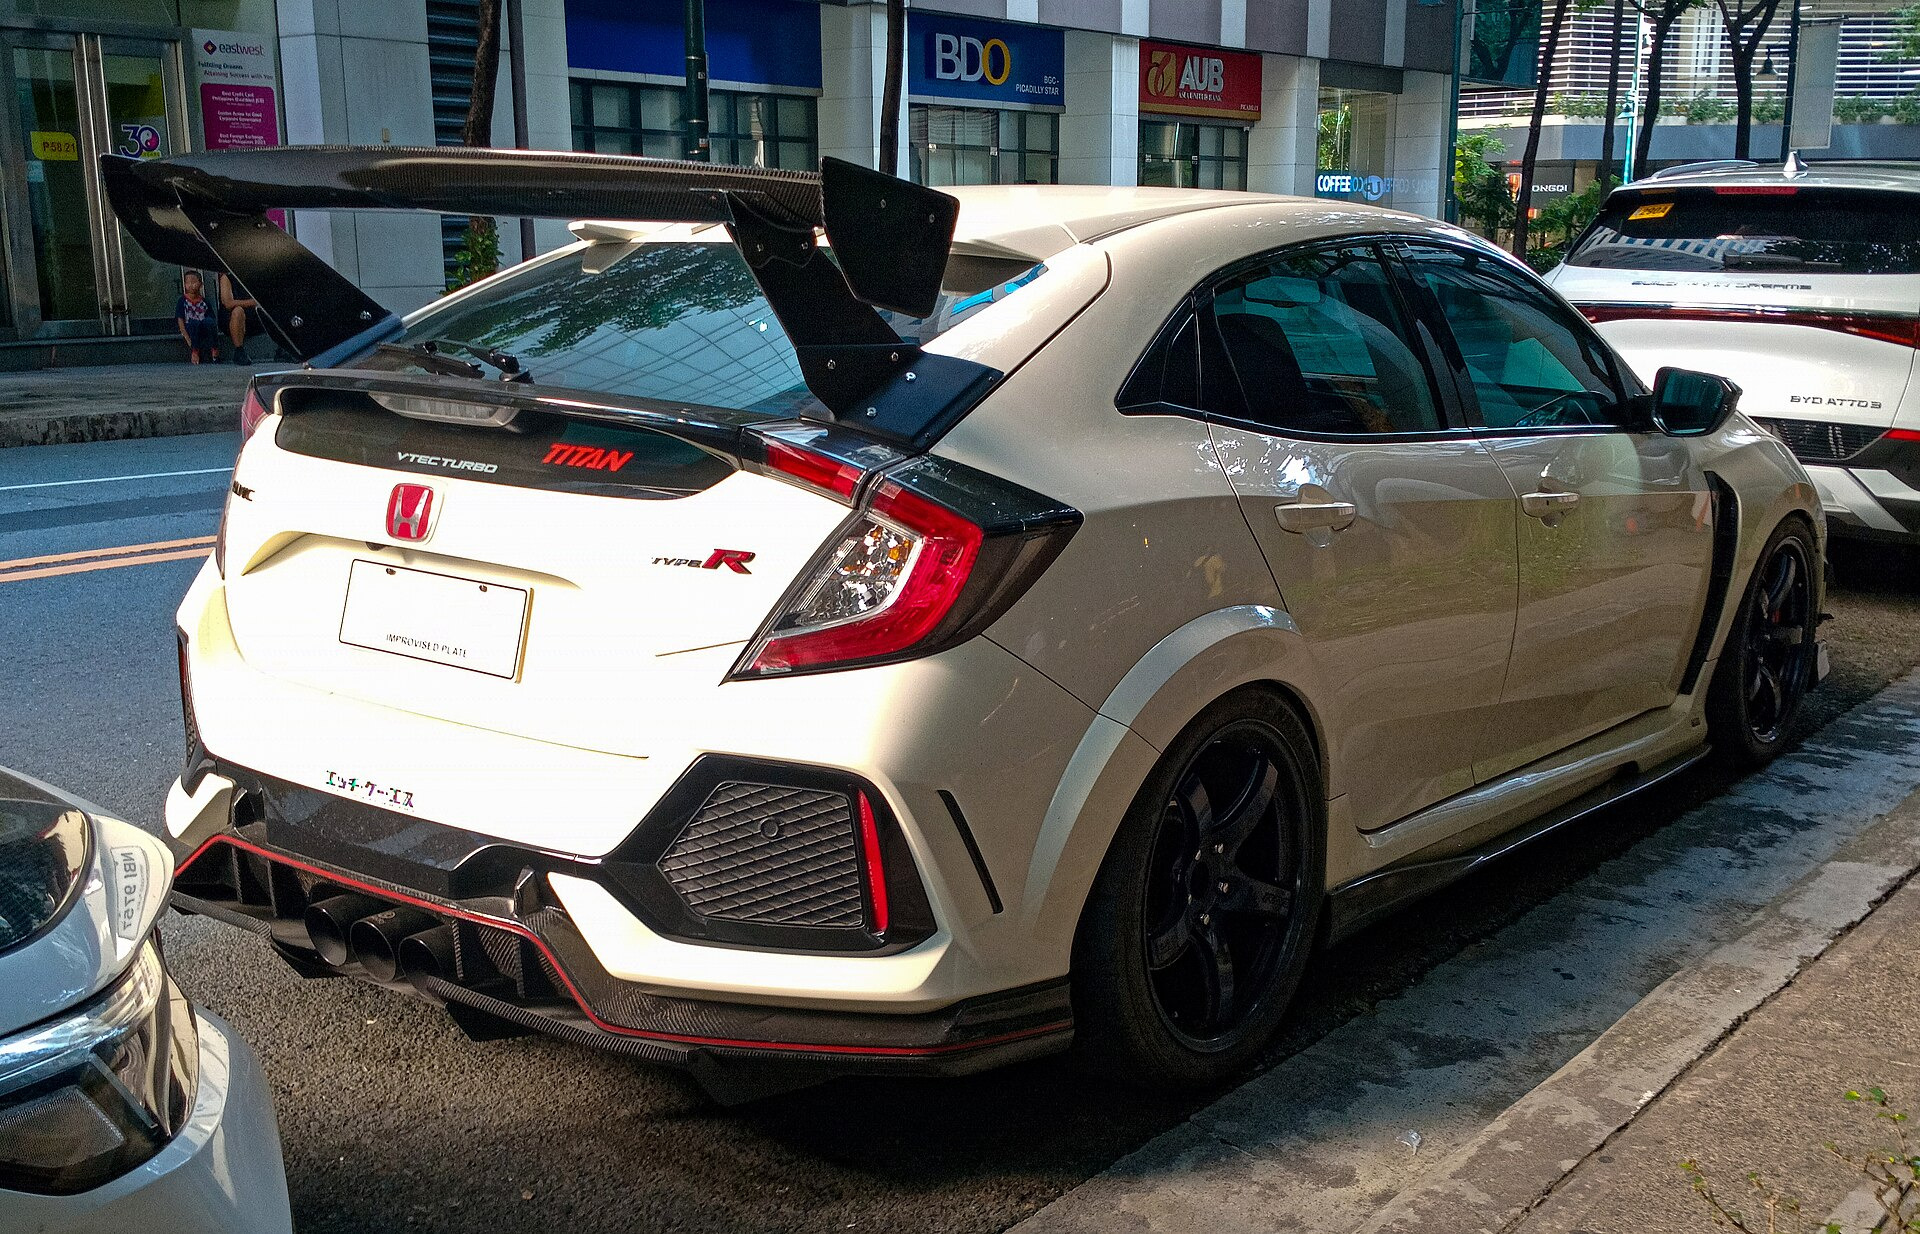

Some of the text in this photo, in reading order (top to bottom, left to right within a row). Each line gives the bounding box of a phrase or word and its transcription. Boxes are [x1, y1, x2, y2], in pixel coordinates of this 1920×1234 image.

[219, 42, 264, 56] eastwest
[935, 33, 1011, 86] BDO
[1179, 55, 1224, 92] AUB
[1015, 83, 1059, 95] PICADILLY STAR
[119, 123, 161, 158] 30
[1317, 174, 1352, 192] COFFEE
[1531, 184, 1568, 193] ONGQI
[1790, 395, 1882, 409] BYD ATTO 3
[397, 451, 498, 474] VTEC TURBO
[540, 442, 634, 472] TITAN
[652, 548, 756, 575] TYPE R
[386, 633, 467, 658] IMPROVISED PLATE
